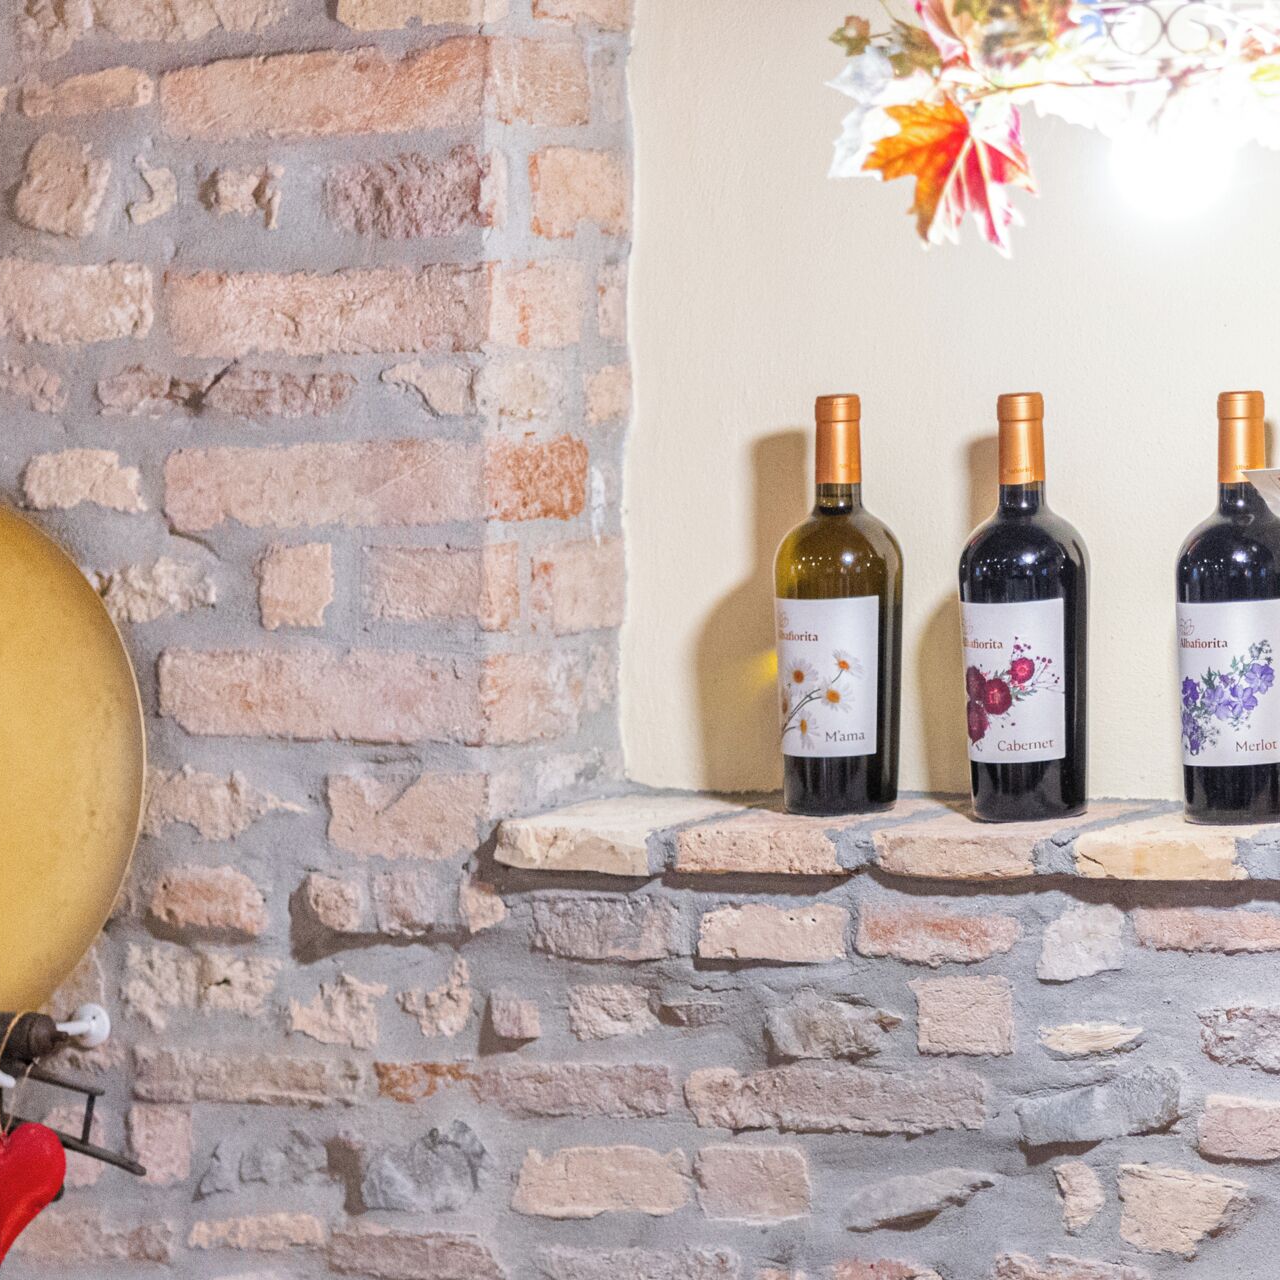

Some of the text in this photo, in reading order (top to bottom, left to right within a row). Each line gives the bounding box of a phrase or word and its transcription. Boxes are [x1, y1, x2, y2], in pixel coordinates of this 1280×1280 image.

[825, 730, 865, 742] M'ama
[997, 739, 1055, 752] Cabernet
[1235, 739, 1278, 752] Merlot
